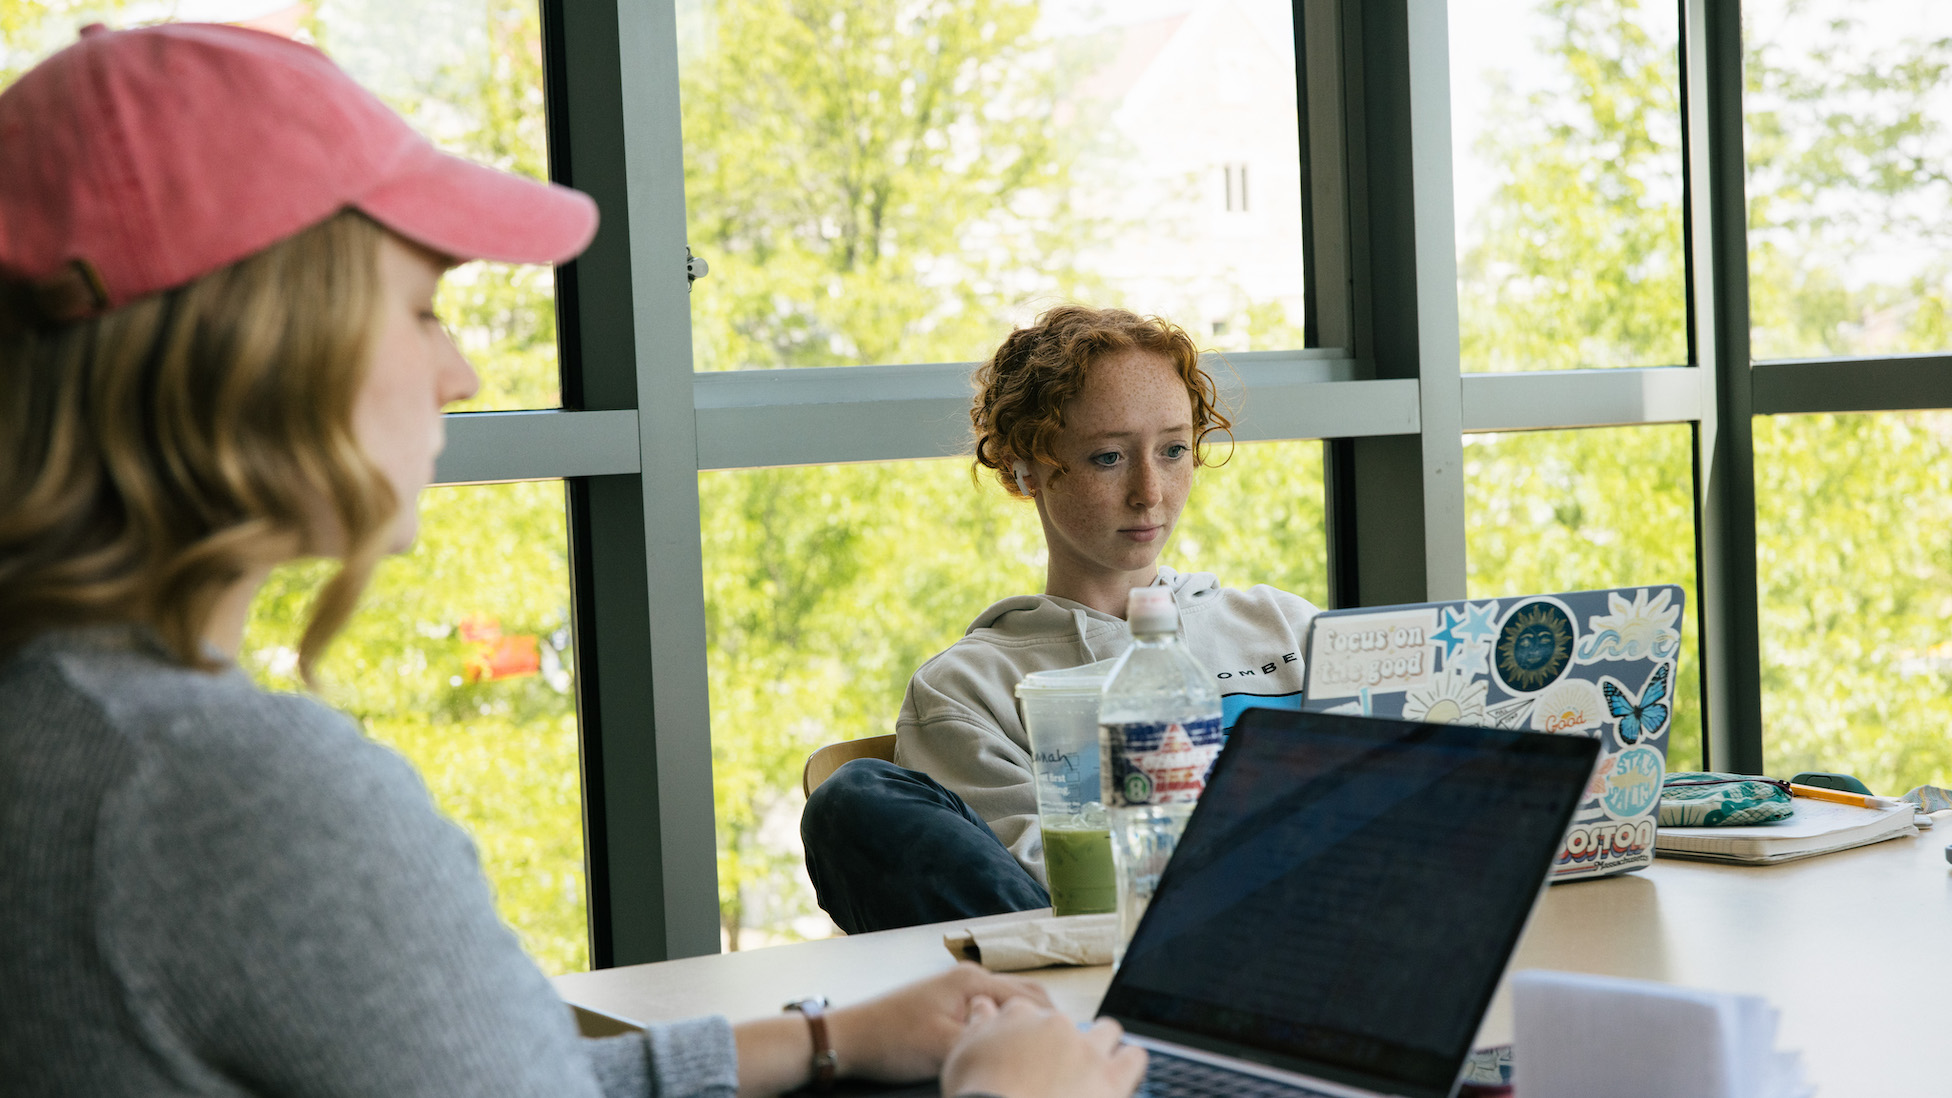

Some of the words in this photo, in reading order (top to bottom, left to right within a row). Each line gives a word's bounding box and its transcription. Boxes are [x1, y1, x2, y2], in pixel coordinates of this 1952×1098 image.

[1394, 627, 1425, 648] on
[1367, 650, 1424, 685] good
[1545, 710, 1586, 734] Good
[1616, 751, 1656, 776] STAY
